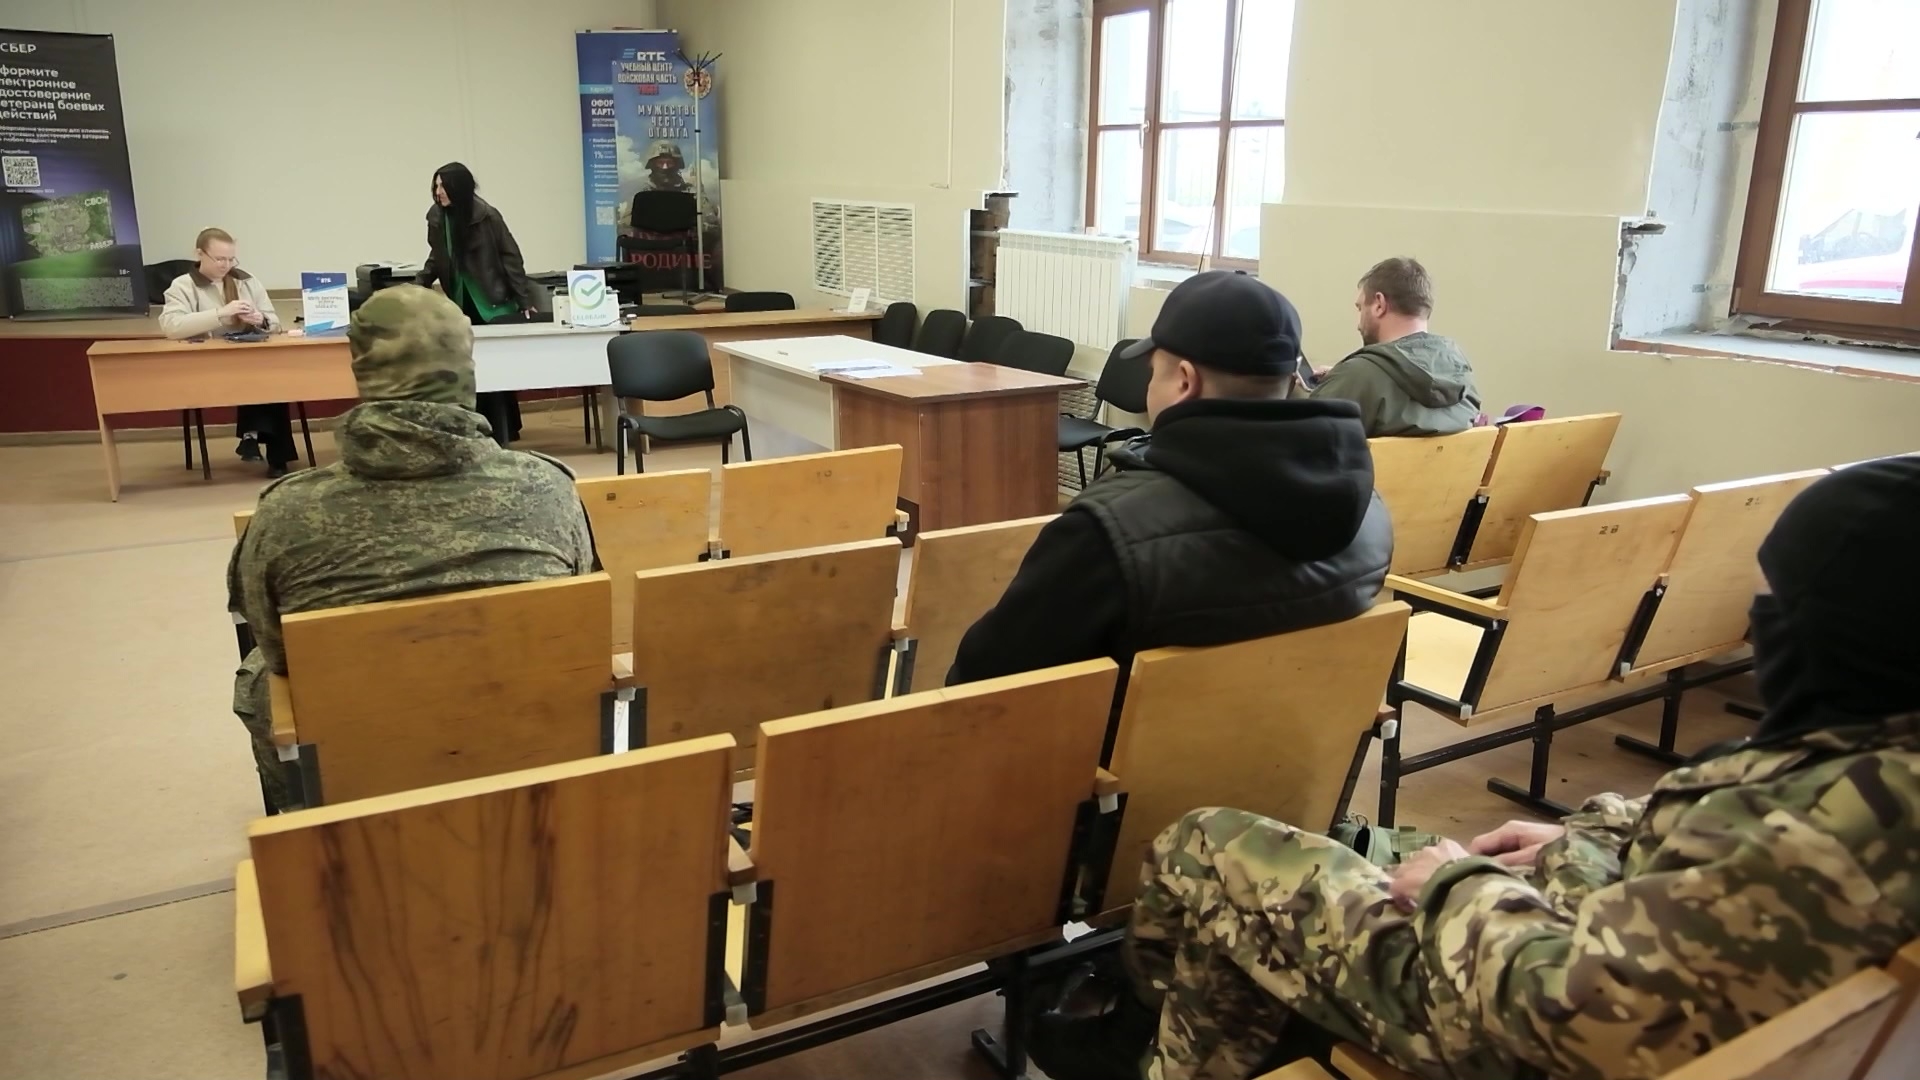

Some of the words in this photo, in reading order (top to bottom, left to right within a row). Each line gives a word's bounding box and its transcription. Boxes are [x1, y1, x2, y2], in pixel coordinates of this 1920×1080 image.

[0, 42, 37, 54] СБЕР
[637, 51, 666, 61] ВТБ
[0, 64, 59, 78] формите
[0, 78, 77, 89] лектронное
[655, 74, 678, 84] ЧАСТЬ
[0, 89, 92, 101] достоверение
[0, 99, 55, 110] етерана
[57, 100, 105, 112] боевых
[591, 99, 614, 108] ОФОР
[651, 116, 685, 127] ЧЕСТЬ
[648, 127, 689, 138] ОТВАГА
